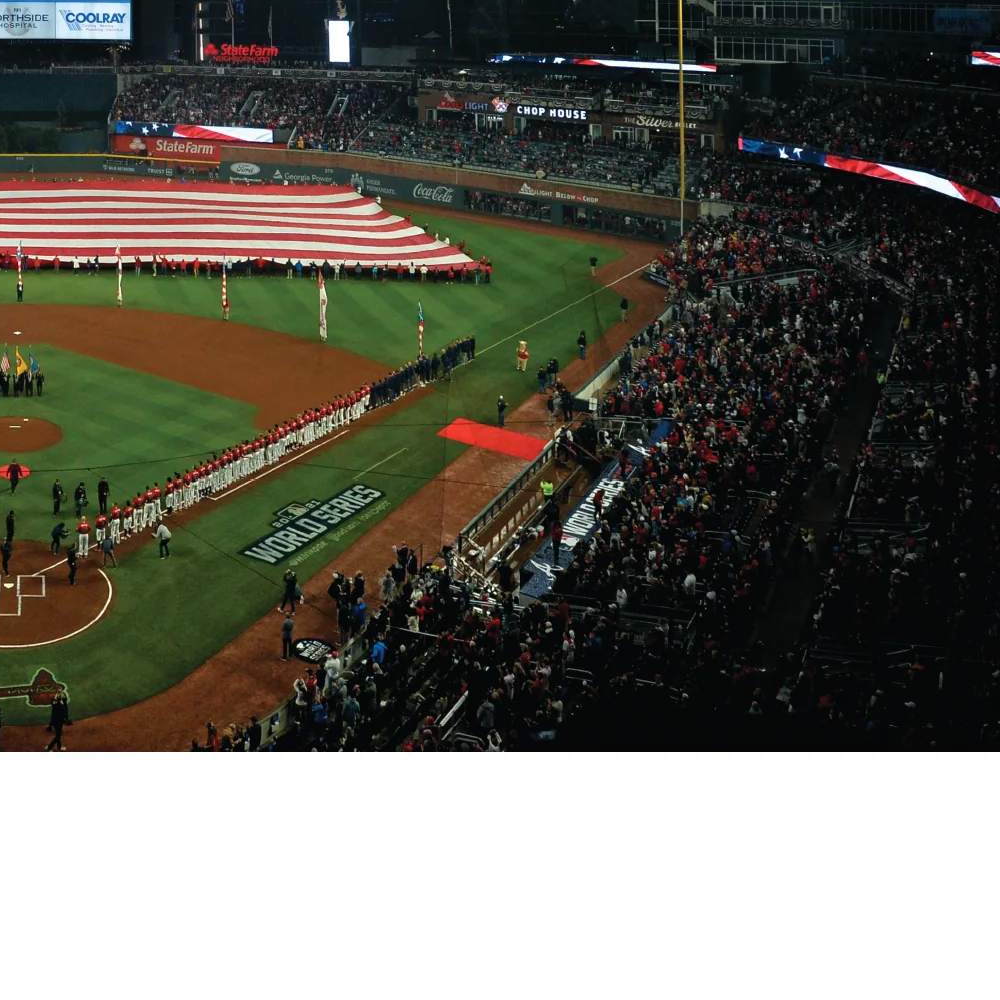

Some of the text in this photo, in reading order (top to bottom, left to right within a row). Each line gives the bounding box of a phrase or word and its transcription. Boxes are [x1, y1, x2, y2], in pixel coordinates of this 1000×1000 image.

[65, 12, 126, 23] COOLRAY
[464, 102, 489, 110] LIGHT
[516, 105, 587, 120] CHOP HOUSE
[635, 115, 673, 128] Silver
[236, 163, 254, 173] Ford
[284, 172, 333, 183] Georgia Power
[413, 182, 455, 203] Coca-Cola
[582, 195, 599, 203] CHOP
[244, 484, 382, 564] WORLD SERIES
[561, 504, 596, 536] WORLD
